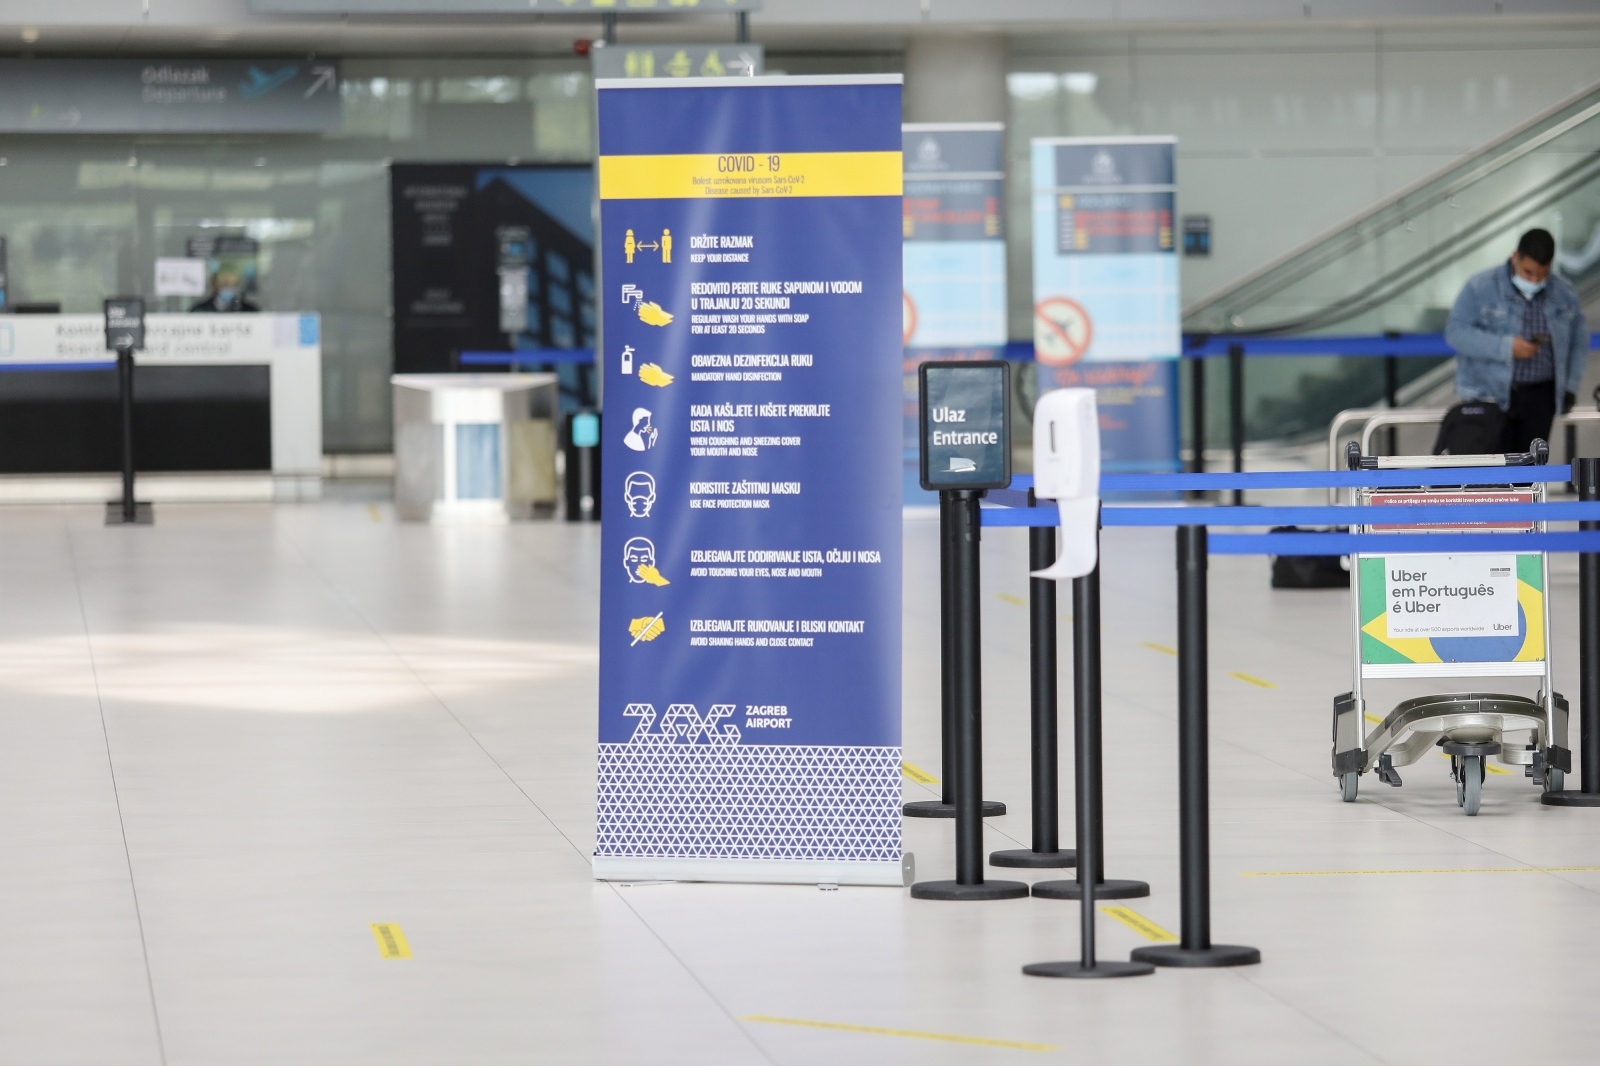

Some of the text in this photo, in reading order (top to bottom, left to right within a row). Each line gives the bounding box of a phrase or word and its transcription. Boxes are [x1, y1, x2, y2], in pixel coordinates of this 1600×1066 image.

[718, 156, 754, 172] COVID
[767, 155, 780, 172] 19
[693, 177, 711, 185] Bolest
[748, 176, 772, 184] virusom
[753, 186, 759, 196] by
[691, 234, 753, 249] DRŽITE RAZMAK
[690, 253, 749, 262] KEEP YOUR DISTANCE
[692, 281, 862, 294] REDOVITO PERITE RUKE SAPUNOM I VODOM
[691, 298, 790, 310] U TRAJANJU 20 SEKUNDI
[692, 314, 809, 323] REGULARLY WASH YOUR HANDS WITH SOAP
[692, 325, 765, 334] FOR AT LEAST 20 SECONDS
[692, 355, 813, 367] OBAVEZNA DEZINFEKCIJA RUKU
[691, 372, 782, 381] MANDATORY HAND DISINFECTION
[691, 402, 830, 416] KADA KAŠLJETE I KIŠETE PREKRIJTE
[932, 407, 966, 422] Ulaz
[690, 420, 734, 432] USTA I NOS
[690, 437, 801, 445] WHEN COUGHING AND SNEEZING COVER
[933, 431, 998, 445] Entrance
[690, 448, 758, 456] YOUR MOUTH AND NOSE
[690, 480, 800, 494] KORISTITE ZAŠTITNU MASKU
[690, 500, 770, 508] USE FACE PROTECTION MASK
[691, 548, 881, 564] IZBJEGAVAJTE DODIRIVANJE USTA, OČIJU I NOSA
[709, 568, 738, 576] TOUCHING
[738, 568, 754, 577] YOUR
[755, 569, 770, 577] EYES,
[771, 569, 787, 577] NOSE
[788, 569, 800, 577] AND
[801, 569, 822, 577] MOUTH
[1392, 570, 1427, 582] Uber
[1392, 584, 1494, 599] em Português
[1393, 601, 1441, 613] é Uber
[690, 620, 864, 633] IZBJEGAVAJTE RUKOVANJE I BLISKI KONTAKT
[690, 638, 814, 646] AVOID SHAKING HANDS AND CLOSE CONTACT
[746, 706, 788, 716] ZAGREB
[746, 718, 793, 728] AIRPORT
